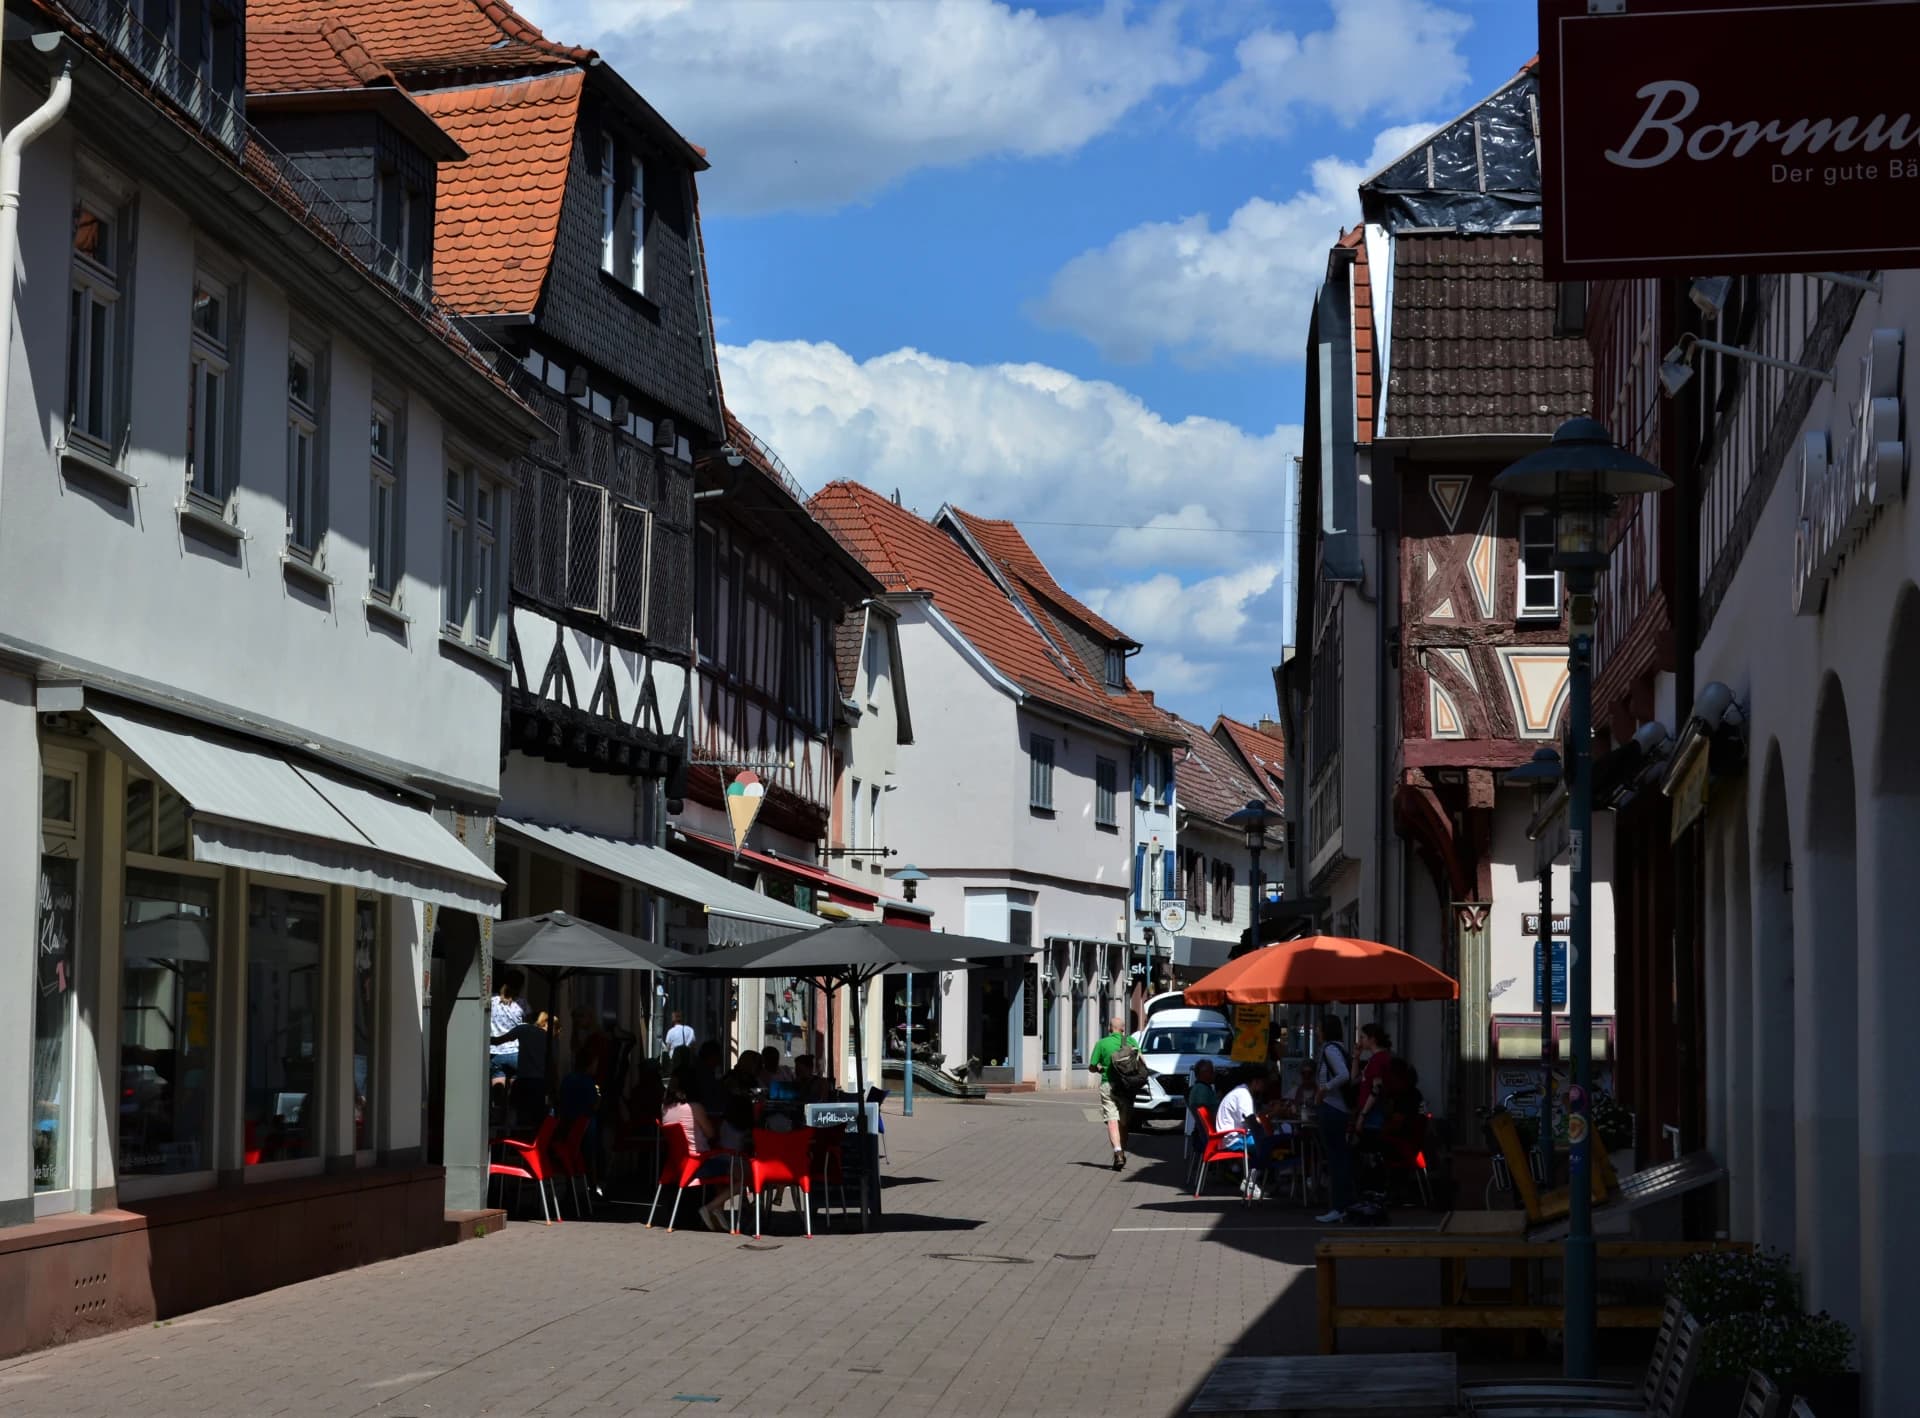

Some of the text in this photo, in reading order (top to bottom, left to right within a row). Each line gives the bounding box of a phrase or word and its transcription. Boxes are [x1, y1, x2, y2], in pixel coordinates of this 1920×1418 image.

[1604, 80, 1920, 168] Bormu
[1772, 158, 1918, 186] Der gute Bä
